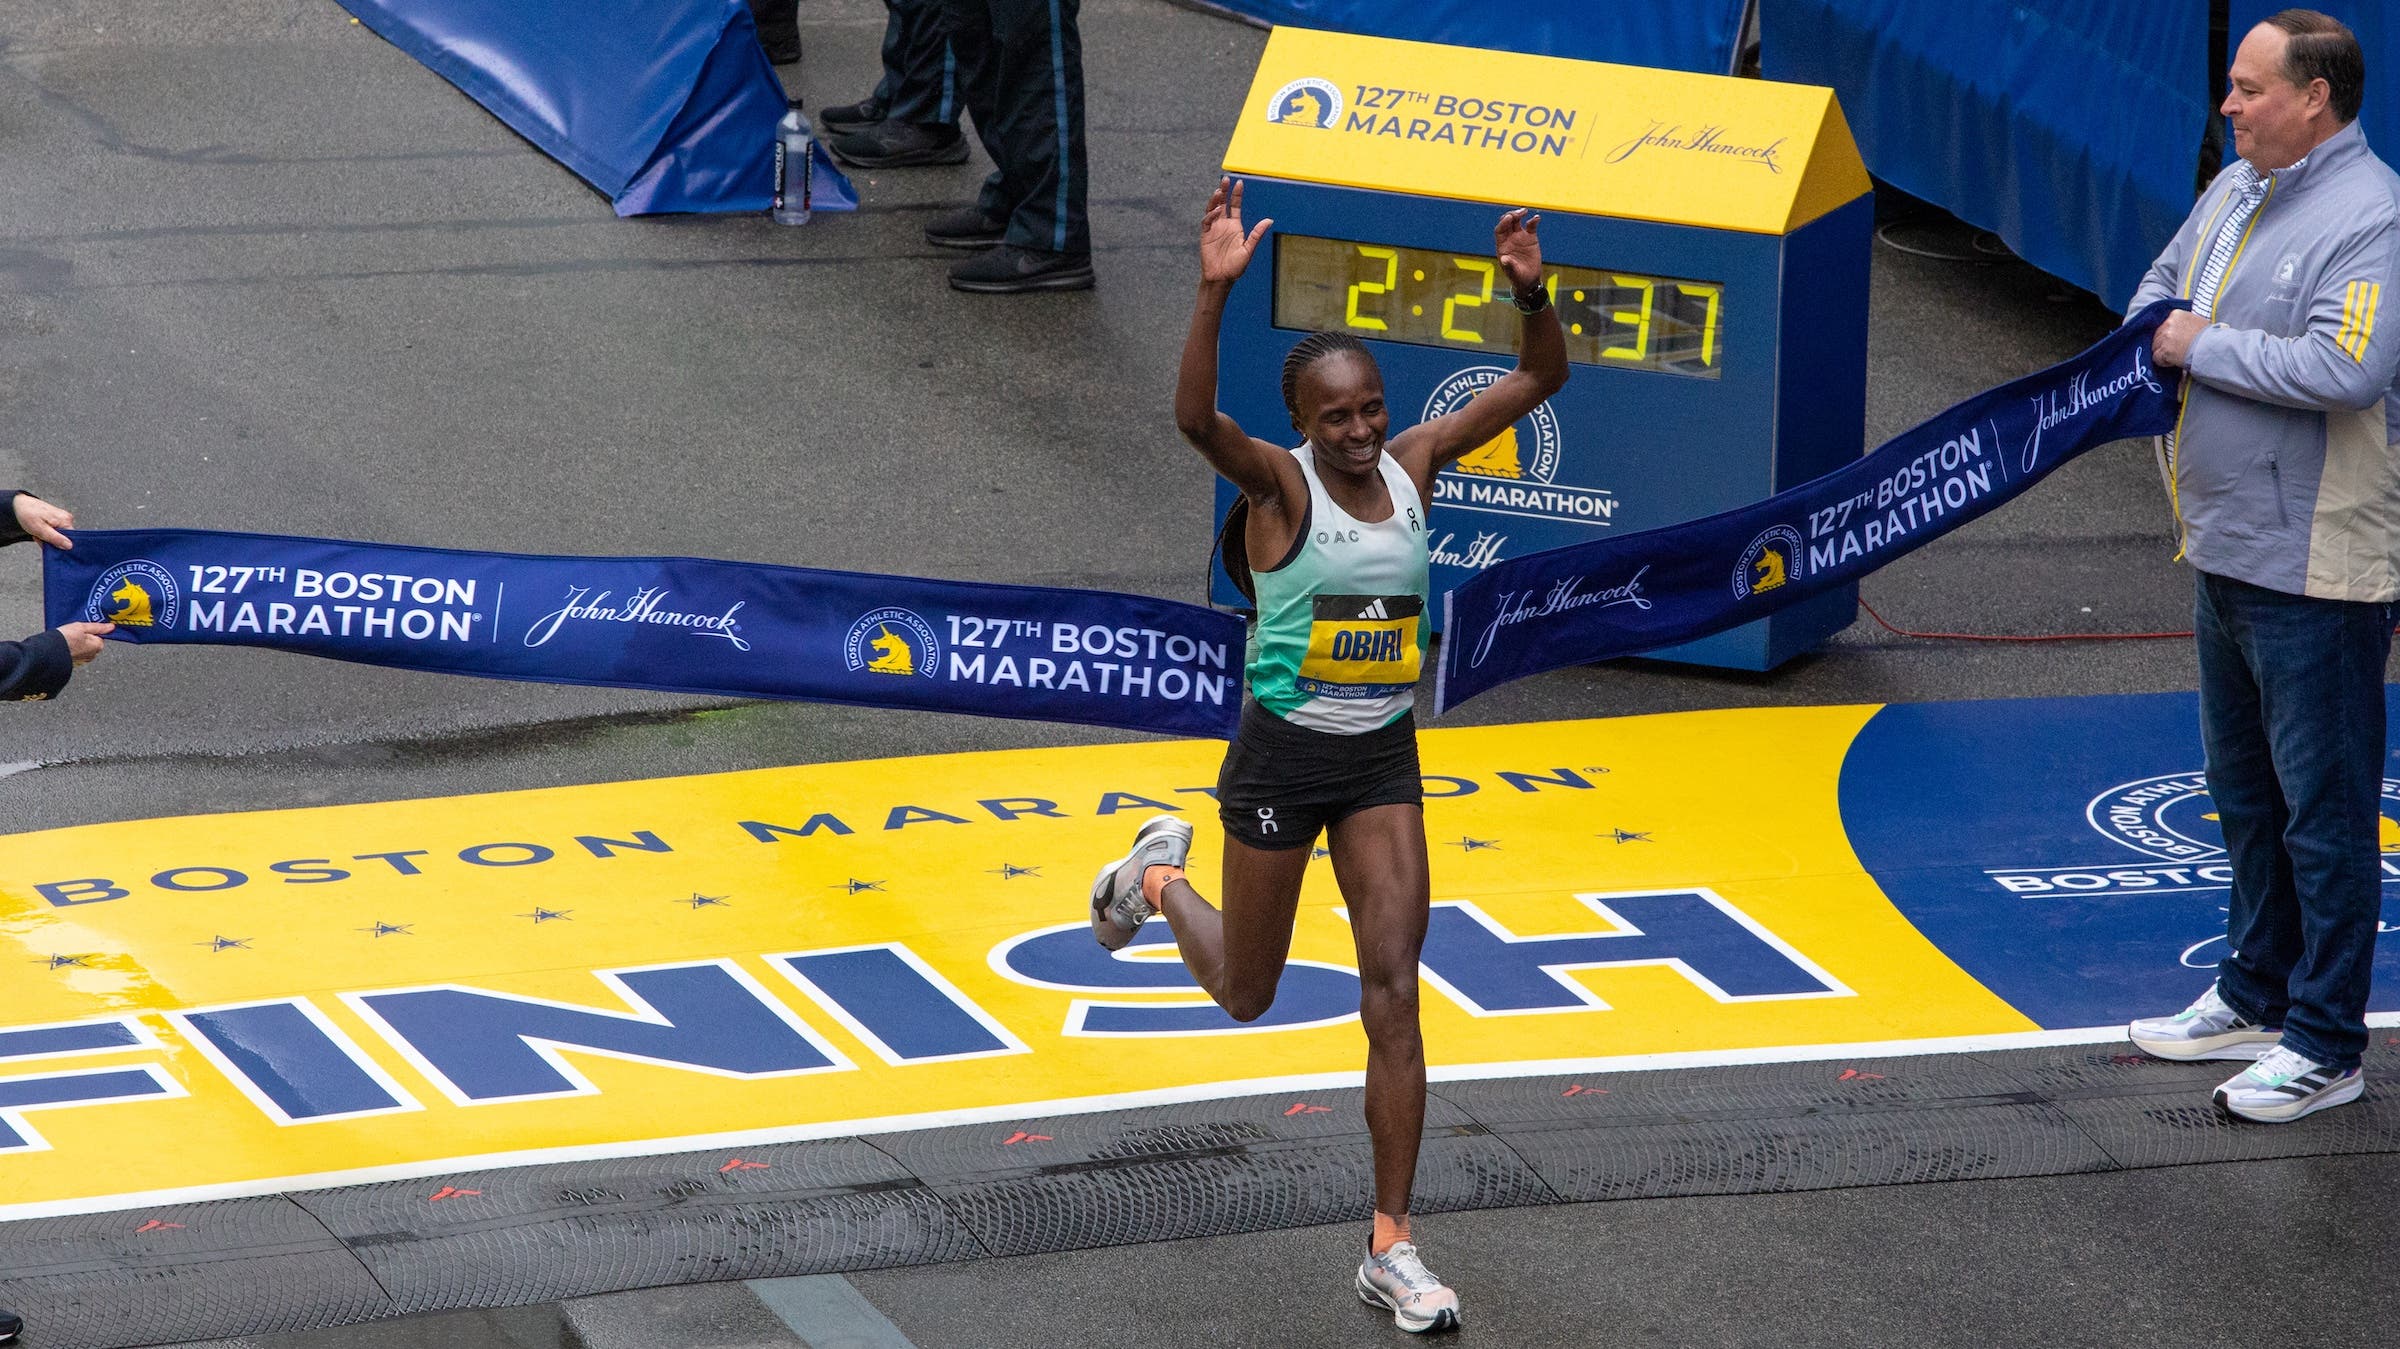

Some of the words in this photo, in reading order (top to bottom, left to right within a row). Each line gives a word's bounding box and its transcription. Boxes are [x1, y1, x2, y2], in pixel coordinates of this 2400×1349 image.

[1355, 85, 1430, 110] 127TH
[1433, 95, 1577, 131] BOSTON
[1604, 119, 1682, 164] John
[1682, 124, 1783, 174] Hancock
[1444, 373, 1505, 402] ATHLETI
[1533, 404, 1555, 476] OCIATION
[2022, 389, 2068, 474] John
[2066, 346, 2163, 416] Hancock
[1809, 488, 1875, 540] 127TH
[1877, 428, 1982, 510] BOSTON
[1316, 530, 1360, 545] OAC
[1736, 557, 1749, 595] BOSTON
[1747, 528, 1781, 558] ATHLETIC
[1780, 528, 1801, 576] ASSOCIATION
[103, 563, 149, 586] ATHLETIC
[147, 567, 176, 624] ASSOCIATION
[189, 565, 286, 594] 127TH
[294, 569, 477, 606] BOSTON
[523, 584, 616, 648] John
[615, 585, 751, 652] Hancock
[848, 628, 863, 667] BOSTON
[859, 610, 905, 631] ATHLETIC
[905, 615, 936, 674] ASSOCIATION
[946, 615, 1042, 649] 127TH
[1052, 623, 1227, 669] BOSTON
[1331, 628, 1403, 662] OBIRI
[1471, 589, 1537, 669] John
[1535, 564, 1653, 617] Hancock
[2120, 777, 2206, 806] ATHL
[2109, 805, 2202, 855] BOSTON
[33, 829, 674, 907] BOSTON
[1993, 867, 2234, 892] BOSTO
[0, 887, 1857, 1154] FINISH
